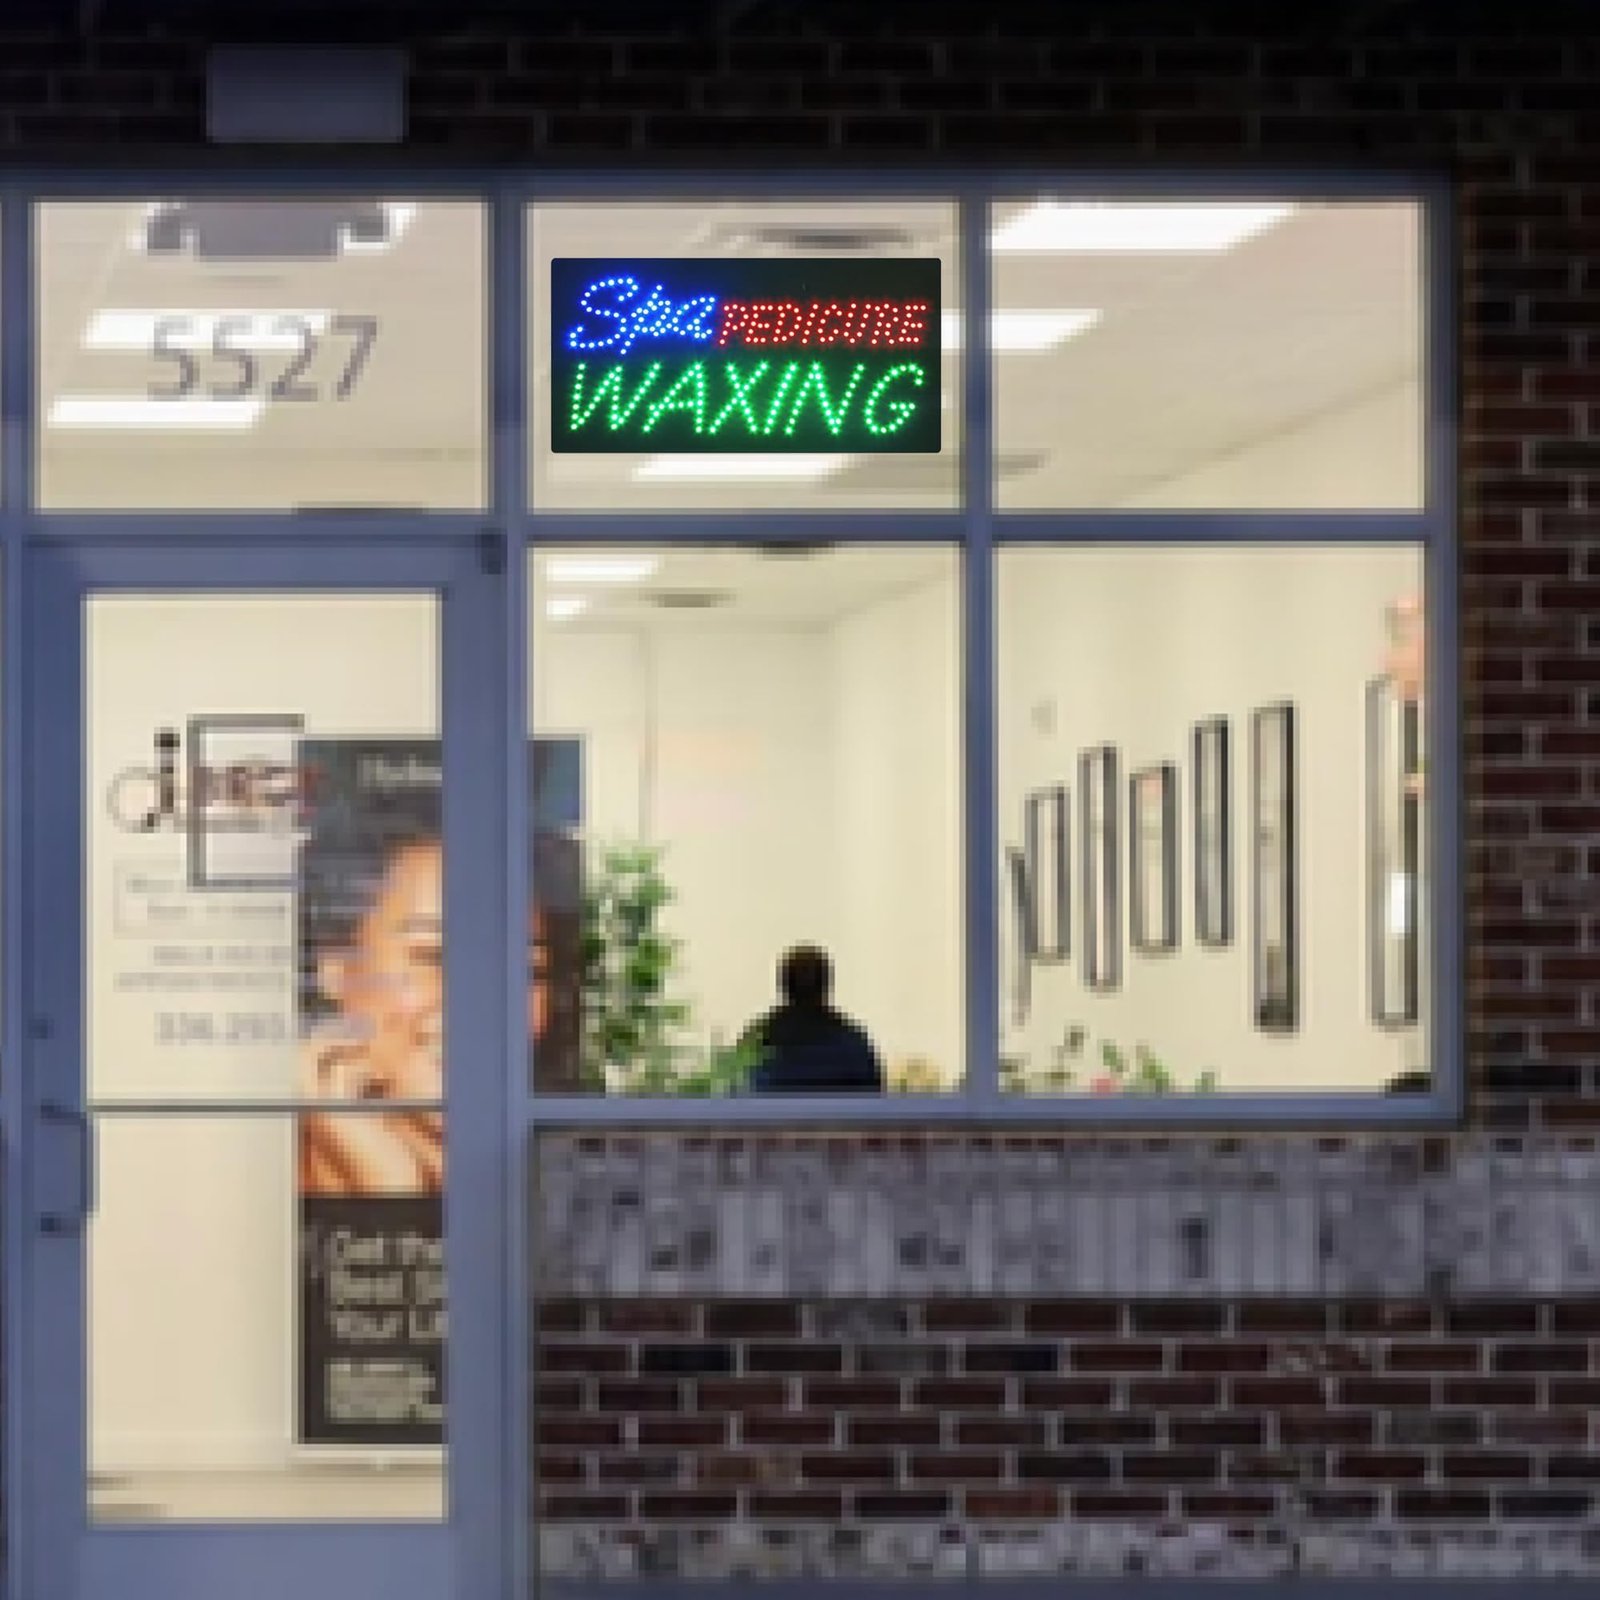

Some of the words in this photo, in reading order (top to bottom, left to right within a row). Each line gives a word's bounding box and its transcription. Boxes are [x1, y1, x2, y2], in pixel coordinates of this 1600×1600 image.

[567, 275, 717, 355] Spa
[718, 302, 929, 346] PEDICURE
[149, 315, 376, 401] 5527
[568, 361, 925, 435] WAXING
